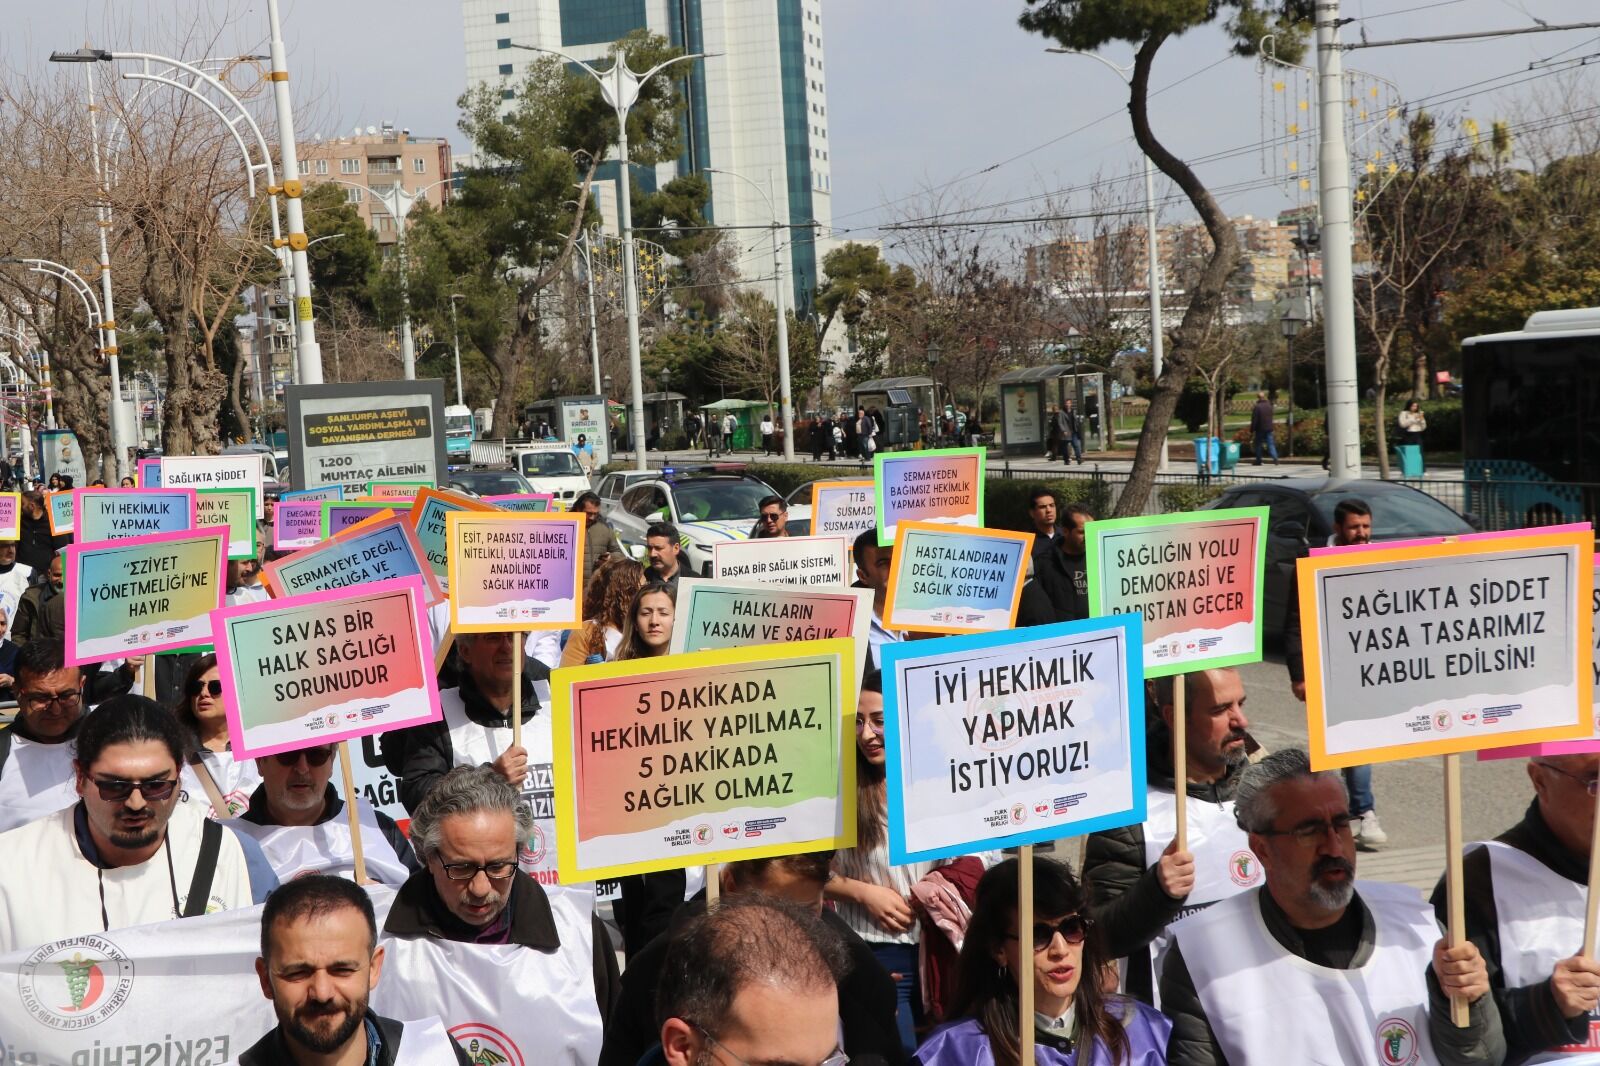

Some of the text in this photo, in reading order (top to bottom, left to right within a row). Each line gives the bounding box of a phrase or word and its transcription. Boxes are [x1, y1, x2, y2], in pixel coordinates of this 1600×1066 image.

[309, 418, 426, 434] SOSYAL YARDIMLAŞMA VE
[328, 409, 408, 423] ŞANLIURFA AŞEVİ
[322, 430, 416, 444] DAYANIŞMA DERNEĞİ
[319, 456, 352, 468] 1.200
[168, 472, 212, 484] SAĞLIKTA
[216, 470, 246, 482] ŞİDDET
[321, 463, 426, 482] MUHTAÇ AİLENİN
[903, 470, 958, 482] SERMAYEDEN
[849, 492, 866, 502] TTB
[890, 480, 970, 496] BAĞIMSIZ HEKİMLİK
[101, 501, 170, 514] İYİ HEKİMLİK
[218, 500, 230, 510] VE
[891, 498, 926, 510] YAPMAK
[112, 519, 160, 530] YAPMAK
[487, 532, 526, 544] PARASIZ,
[530, 531, 568, 544] BİLİMSEL
[464, 547, 506, 560] NİTELİKLİ,
[916, 546, 1008, 566] HASTALANDIRAN
[1117, 538, 1240, 568] SAĞLIĞIN YOLU
[290, 540, 402, 589] SERMAYEYE DEĞİL,
[372, 560, 390, 574] VE
[490, 562, 542, 575] ANADİLİNDE
[722, 554, 836, 577] BAŞKA BİR SAĞLIK SİSTEMİ,
[912, 562, 1006, 582] DEĞİL, KORUYAN
[482, 578, 549, 590] SAĞLIK HAKTIR
[810, 572, 841, 584] ORTAMI
[1121, 564, 1236, 596] DEMOKRASİ VE
[912, 581, 998, 599] SAĞLIK SİSTEMİ
[1342, 576, 1550, 620] SAĞLIKTA ŞİDDET
[129, 598, 170, 618] HAYIR
[732, 600, 814, 620] HALKLARIN
[1192, 591, 1244, 614] GEÇER
[272, 609, 374, 646] SAVAŞ BİR
[702, 620, 756, 639] YAŞAM
[762, 624, 780, 641] VE
[1348, 611, 1546, 654] YASA TASARIMIZ
[258, 634, 396, 676] HALK SAĞLIĞI
[1360, 643, 1536, 688] KABUL EDİLSİN!
[274, 664, 389, 702] SORUNUDUR
[934, 650, 1094, 706] İYİ HEKİMLİK
[636, 680, 776, 714] 5 DAKİKADA
[591, 707, 822, 752] HEKİMLİK YAPILMAZ,
[962, 700, 1075, 746] YAPMAK
[638, 743, 778, 778] 5 DAKİKADA
[950, 741, 1089, 794] İSTİYORUZ!
[624, 773, 794, 812] SAĞLIK OLMAZ
